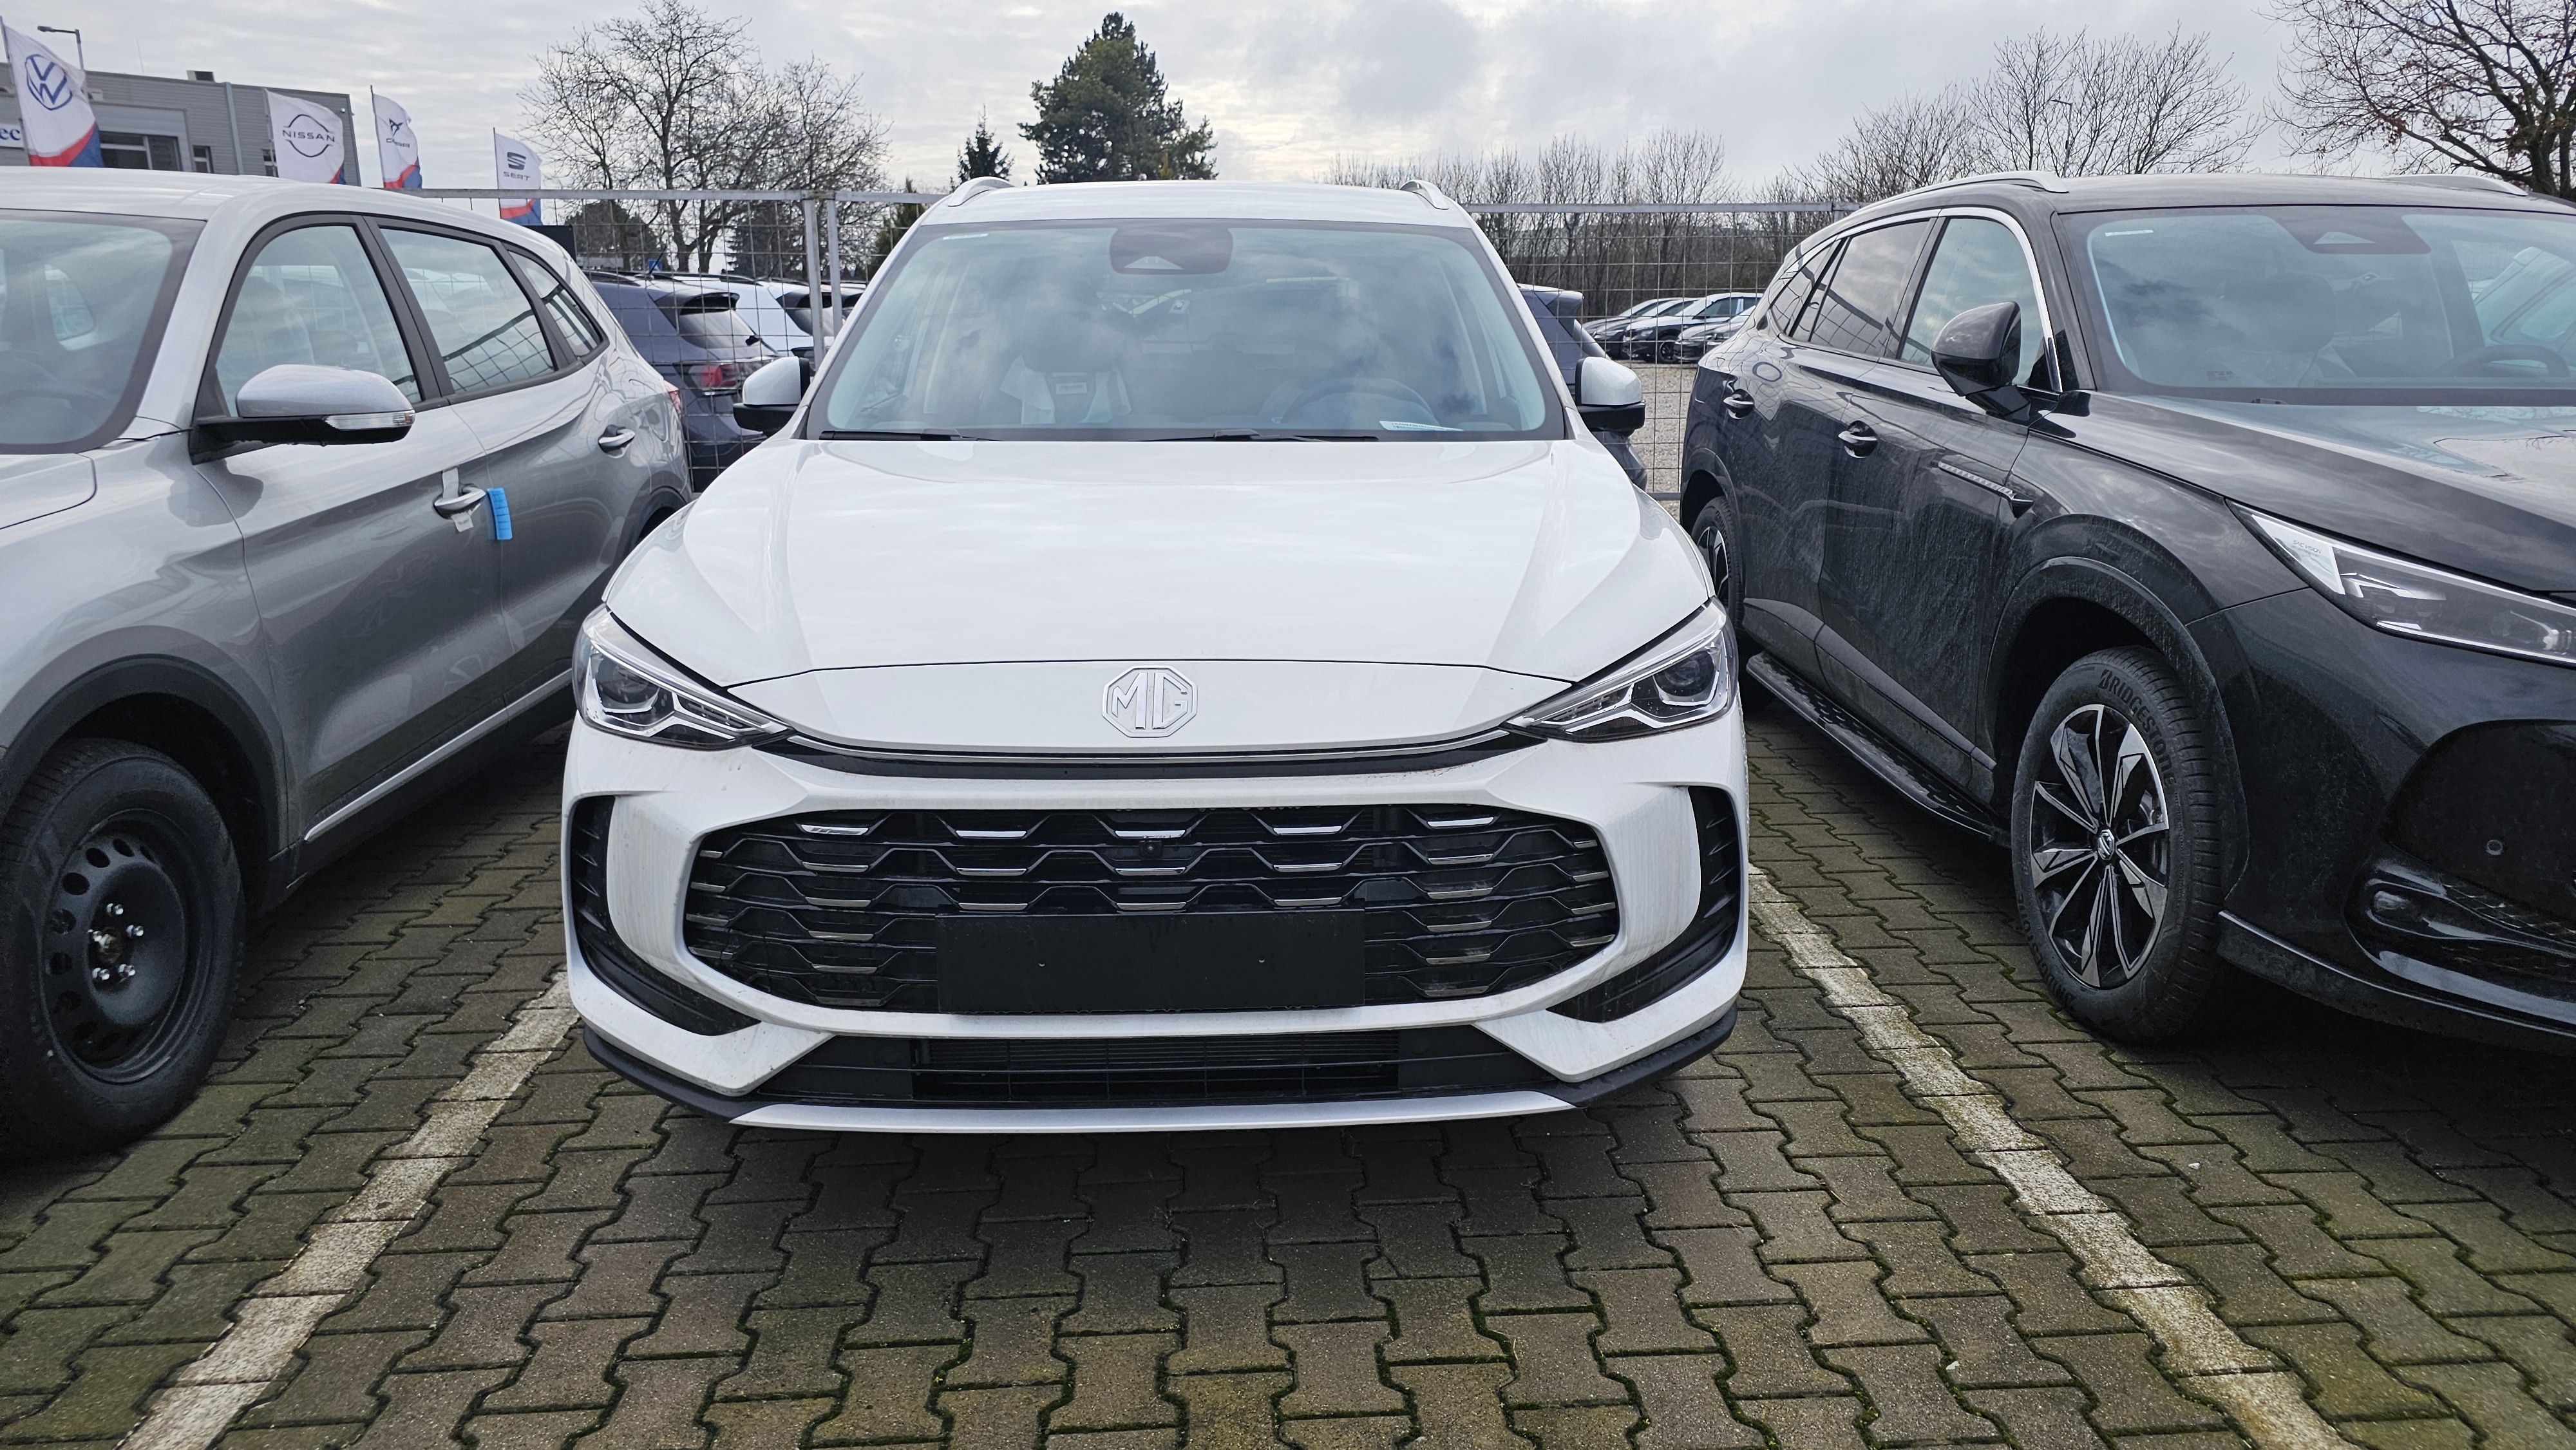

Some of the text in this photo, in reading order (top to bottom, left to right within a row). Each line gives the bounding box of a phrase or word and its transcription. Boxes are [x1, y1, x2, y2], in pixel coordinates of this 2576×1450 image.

[282, 130, 335, 142] NISSAN
[503, 171, 531, 181] SEAT
[1112, 672, 1188, 730] MG
[2098, 669, 2177, 787] BRIDGESTONE
